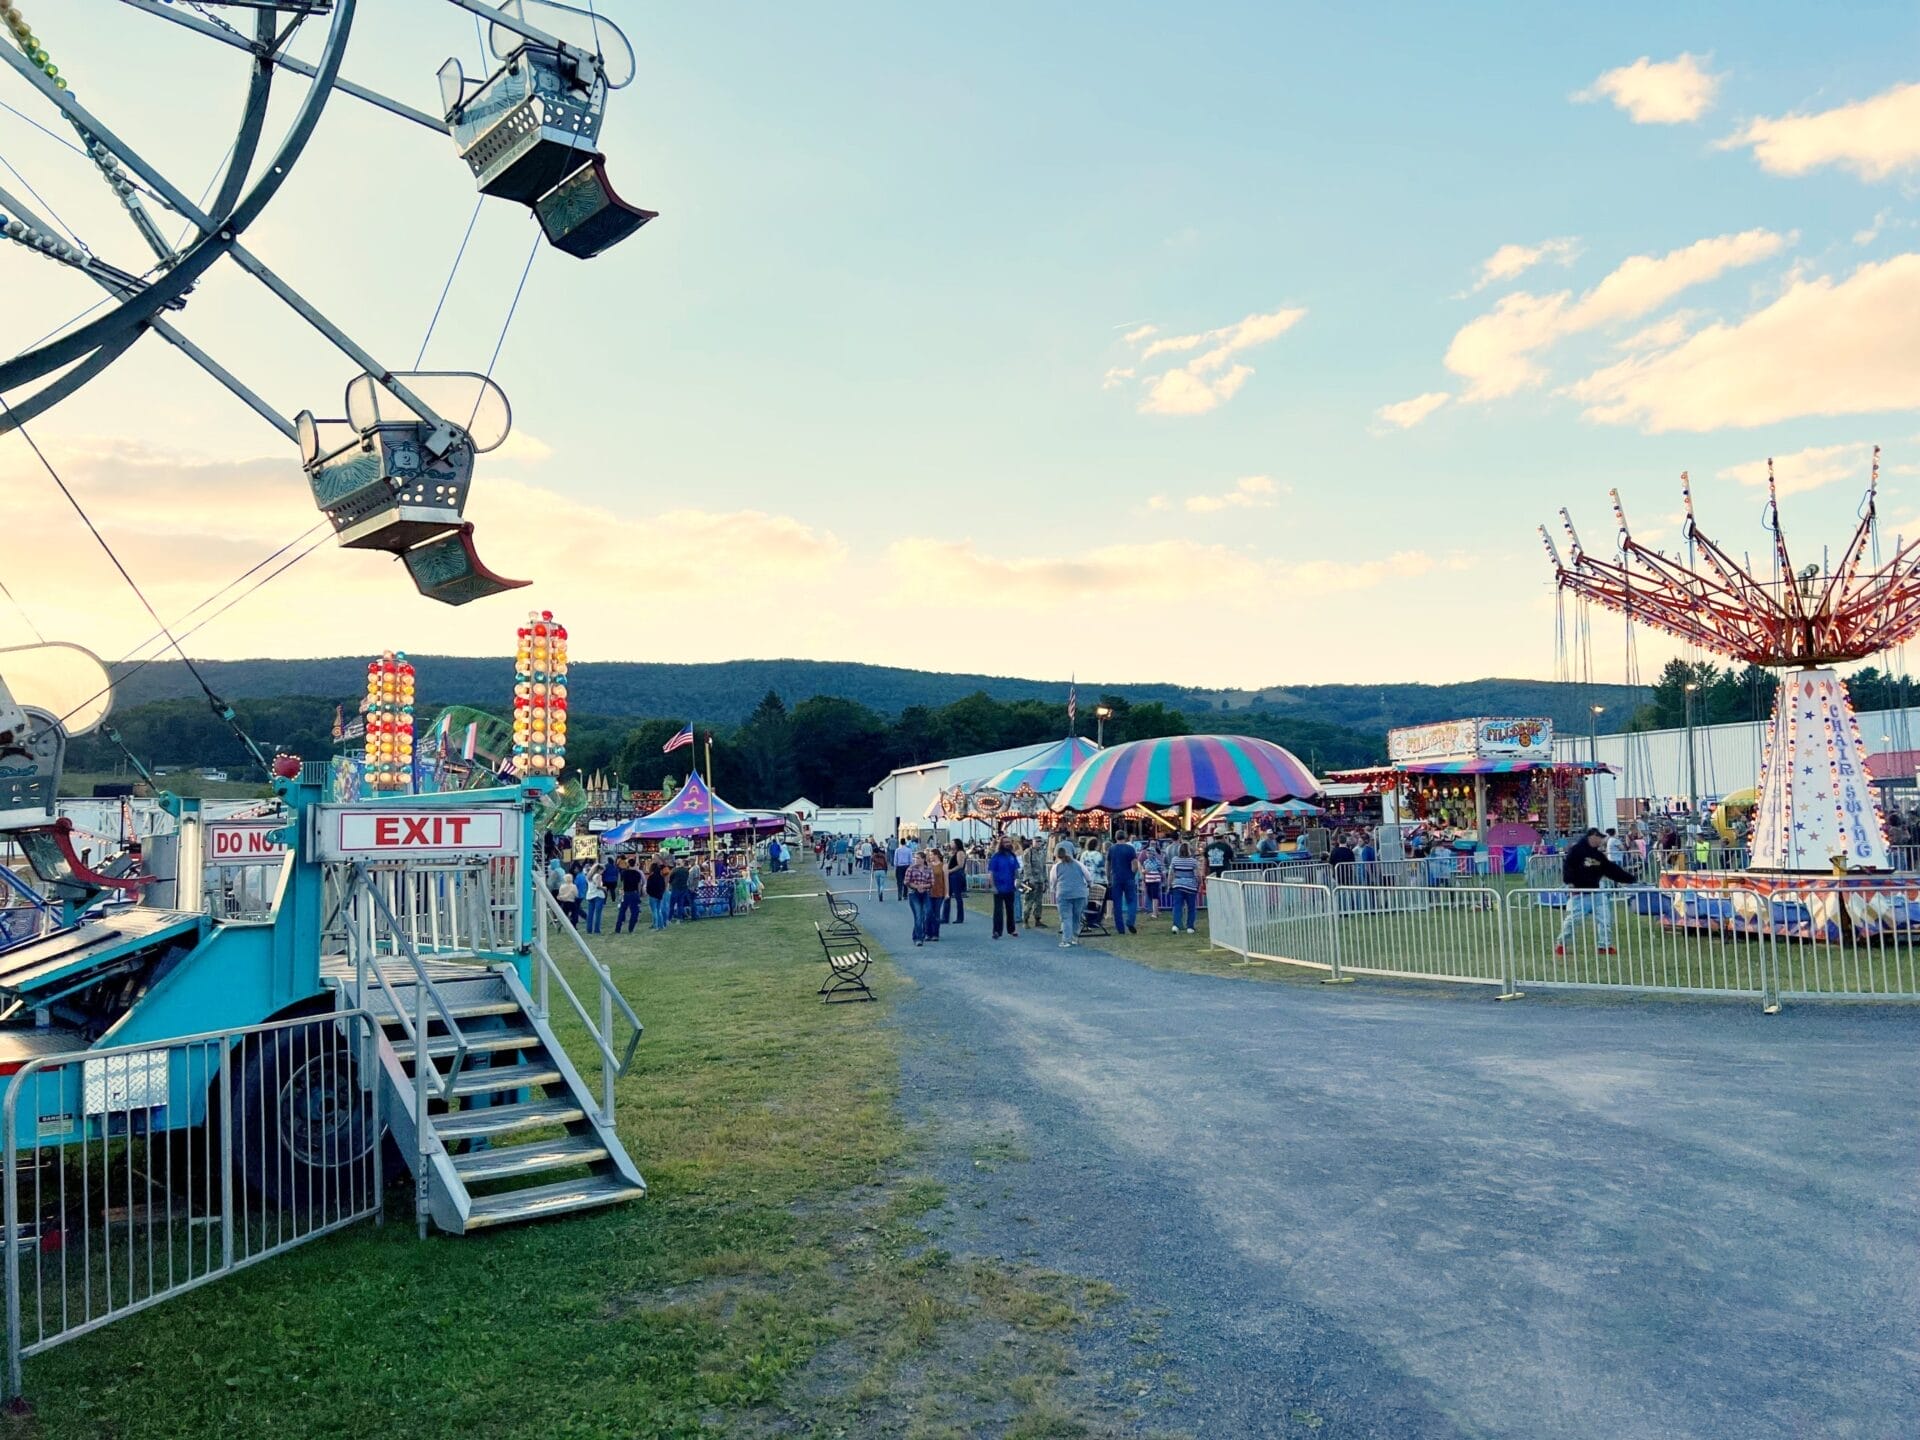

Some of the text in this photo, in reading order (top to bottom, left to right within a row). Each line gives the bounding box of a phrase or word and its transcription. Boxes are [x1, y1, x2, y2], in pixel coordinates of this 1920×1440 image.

[402, 455, 411, 465] 2
[1829, 704, 1872, 858] CHAIR SWING
[217, 832, 243, 853] DO
[375, 817, 471, 845] EXIT
